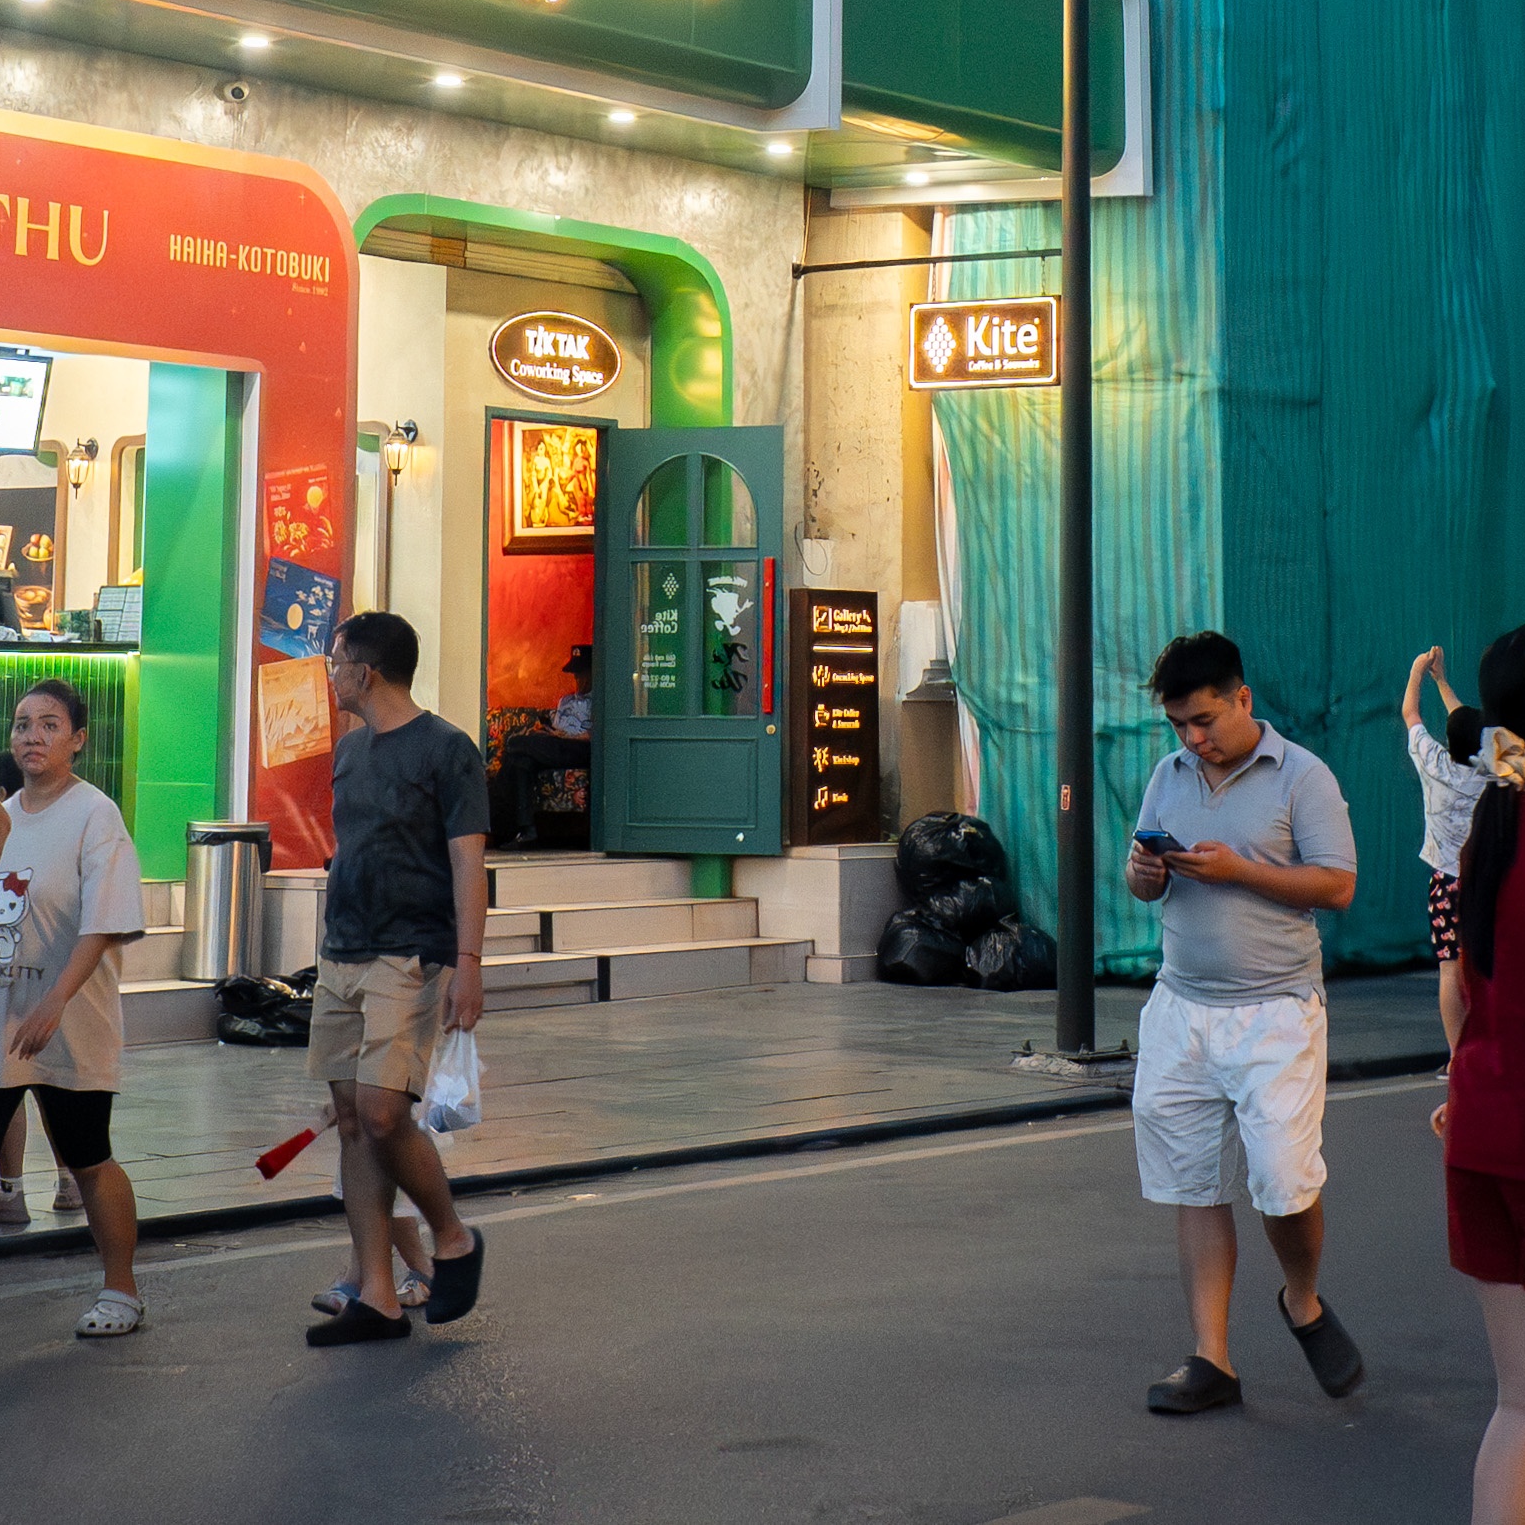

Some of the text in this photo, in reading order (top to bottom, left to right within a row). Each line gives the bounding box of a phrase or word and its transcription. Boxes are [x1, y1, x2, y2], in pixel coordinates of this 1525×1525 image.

[170, 234, 331, 283] HAIHA-KOTOBUKI
[967, 315, 1039, 357] Kite
[510, 358, 604, 387] Coworking Space
